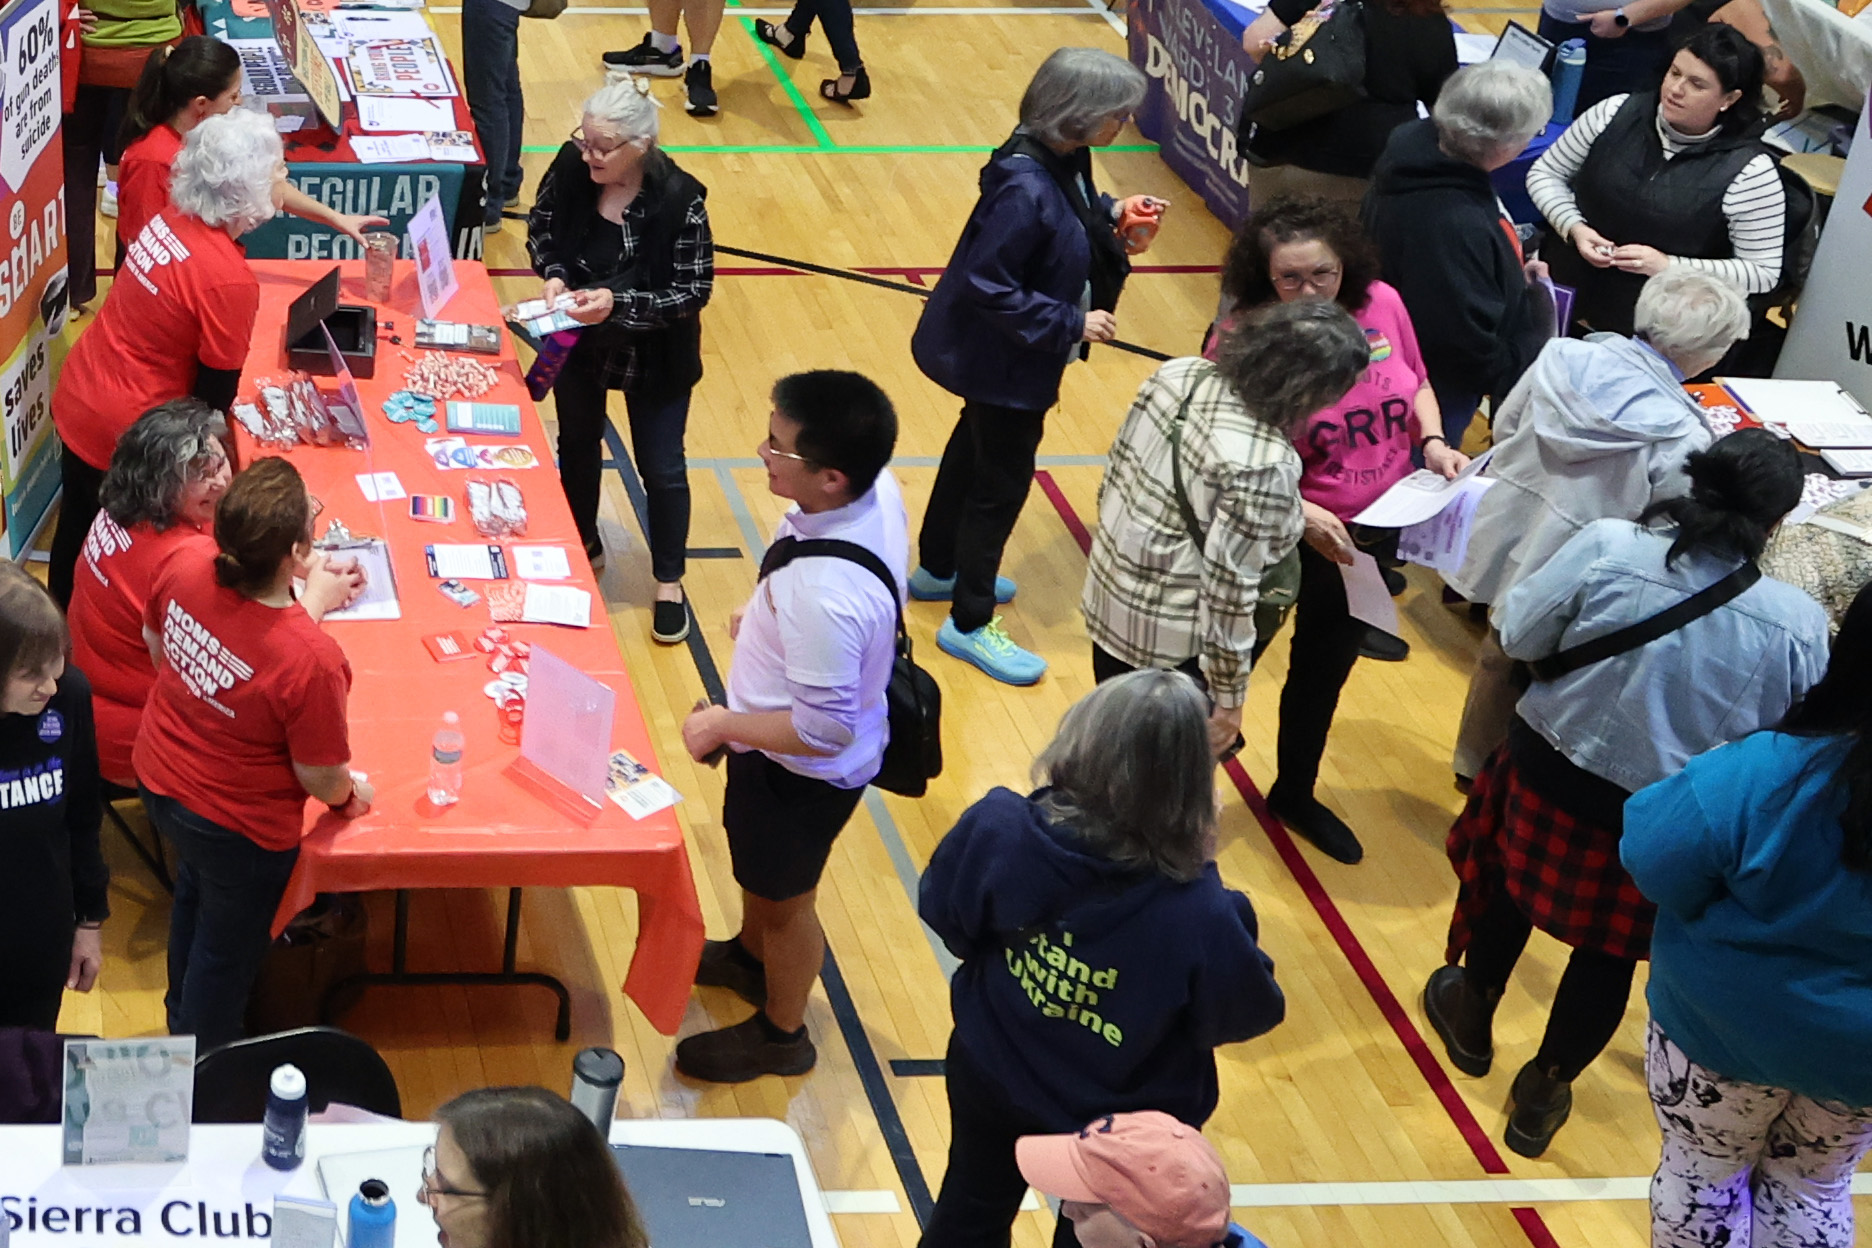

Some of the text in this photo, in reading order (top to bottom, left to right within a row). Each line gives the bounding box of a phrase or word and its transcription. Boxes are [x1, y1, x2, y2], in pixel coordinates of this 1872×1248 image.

[19, 9, 54, 76] 60%
[387, 45, 423, 81] PEOPLE
[4, 50, 59, 122] of gun deaths
[15, 87, 53, 139] are from
[1145, 33, 1250, 189] DEMOCRA
[21, 115, 51, 160] suicide
[12, 209, 23, 231] BE
[277, 174, 441, 219] EGULAR
[4, 341, 45, 417] saves
[11, 392, 45, 459] lives
[164, 614, 235, 690] DEMAND
[167, 598, 221, 656] MOMS
[1024, 950, 1099, 1006] with
[1029, 932, 1119, 990] tand
[1005, 947, 1123, 1048] Ukraine
[1, 1195, 273, 1239] Sierra Club
